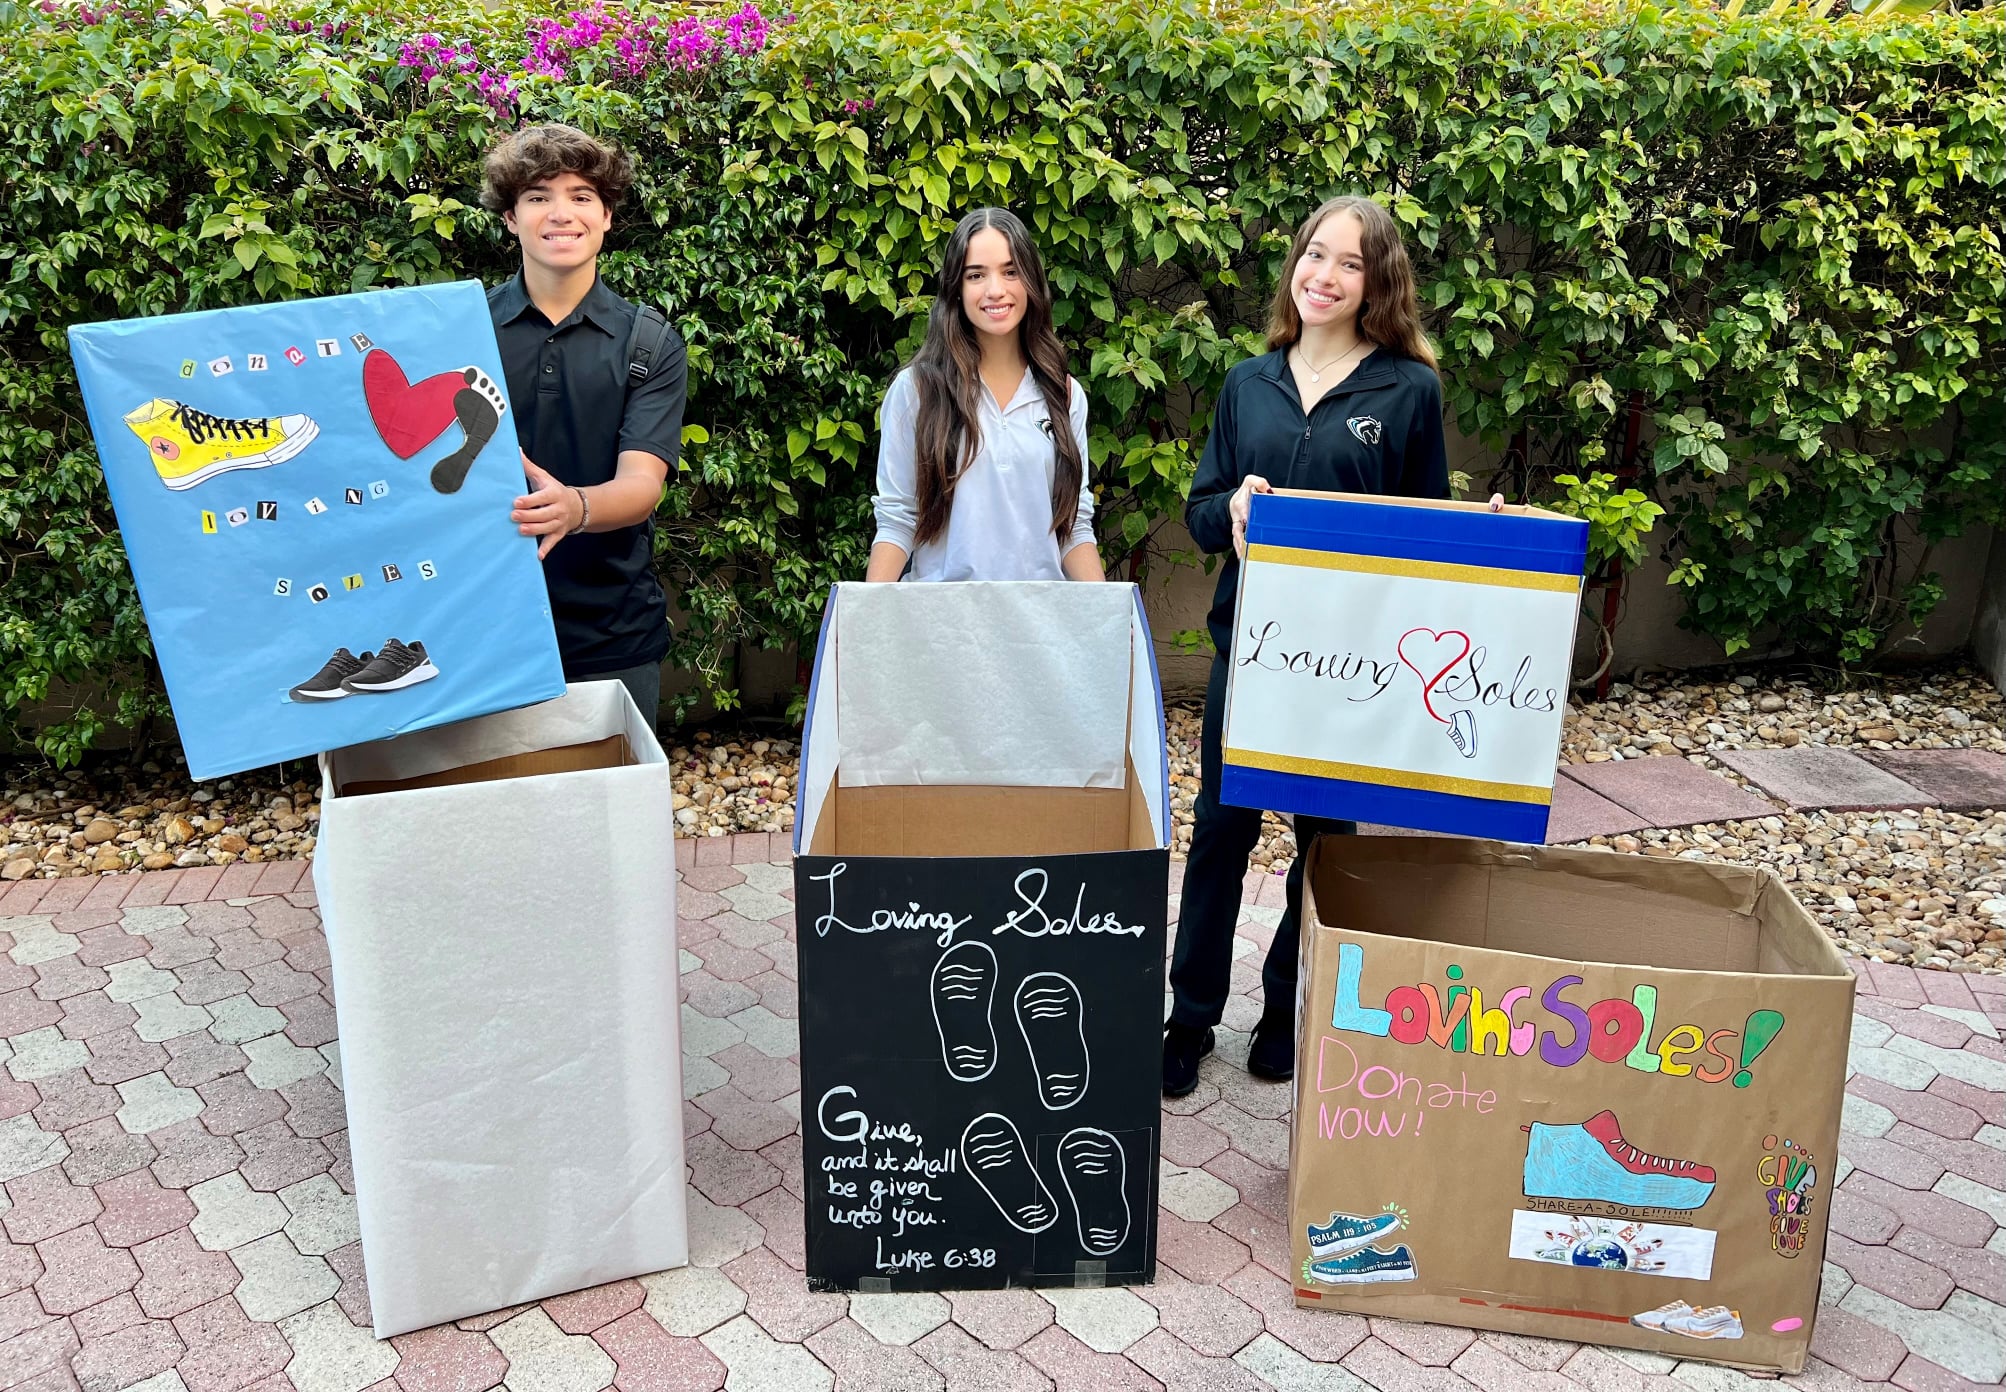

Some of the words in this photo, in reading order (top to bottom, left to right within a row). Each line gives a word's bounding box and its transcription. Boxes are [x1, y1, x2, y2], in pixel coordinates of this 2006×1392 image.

[1237, 620, 1399, 702] Loving
[1434, 646, 1557, 712] Soles
[809, 862, 972, 947] Loving
[1317, 1035, 1497, 1114] Donate
[818, 1085, 923, 1147] Give,
[1318, 1101, 1424, 1141] NOW!
[821, 1145, 867, 1171] and
[874, 1147, 899, 1171] it
[902, 1147, 956, 1178] shall
[828, 1174, 858, 1198] be
[869, 1177, 942, 1210] given
[828, 1204, 882, 1229] unto
[892, 1206, 946, 1237] you.
[1311, 1230, 1341, 1245] PSALM
[1343, 1227, 1355, 1237] 119
[875, 1236, 936, 1272] Luke
[943, 1247, 996, 1268] 6:38
